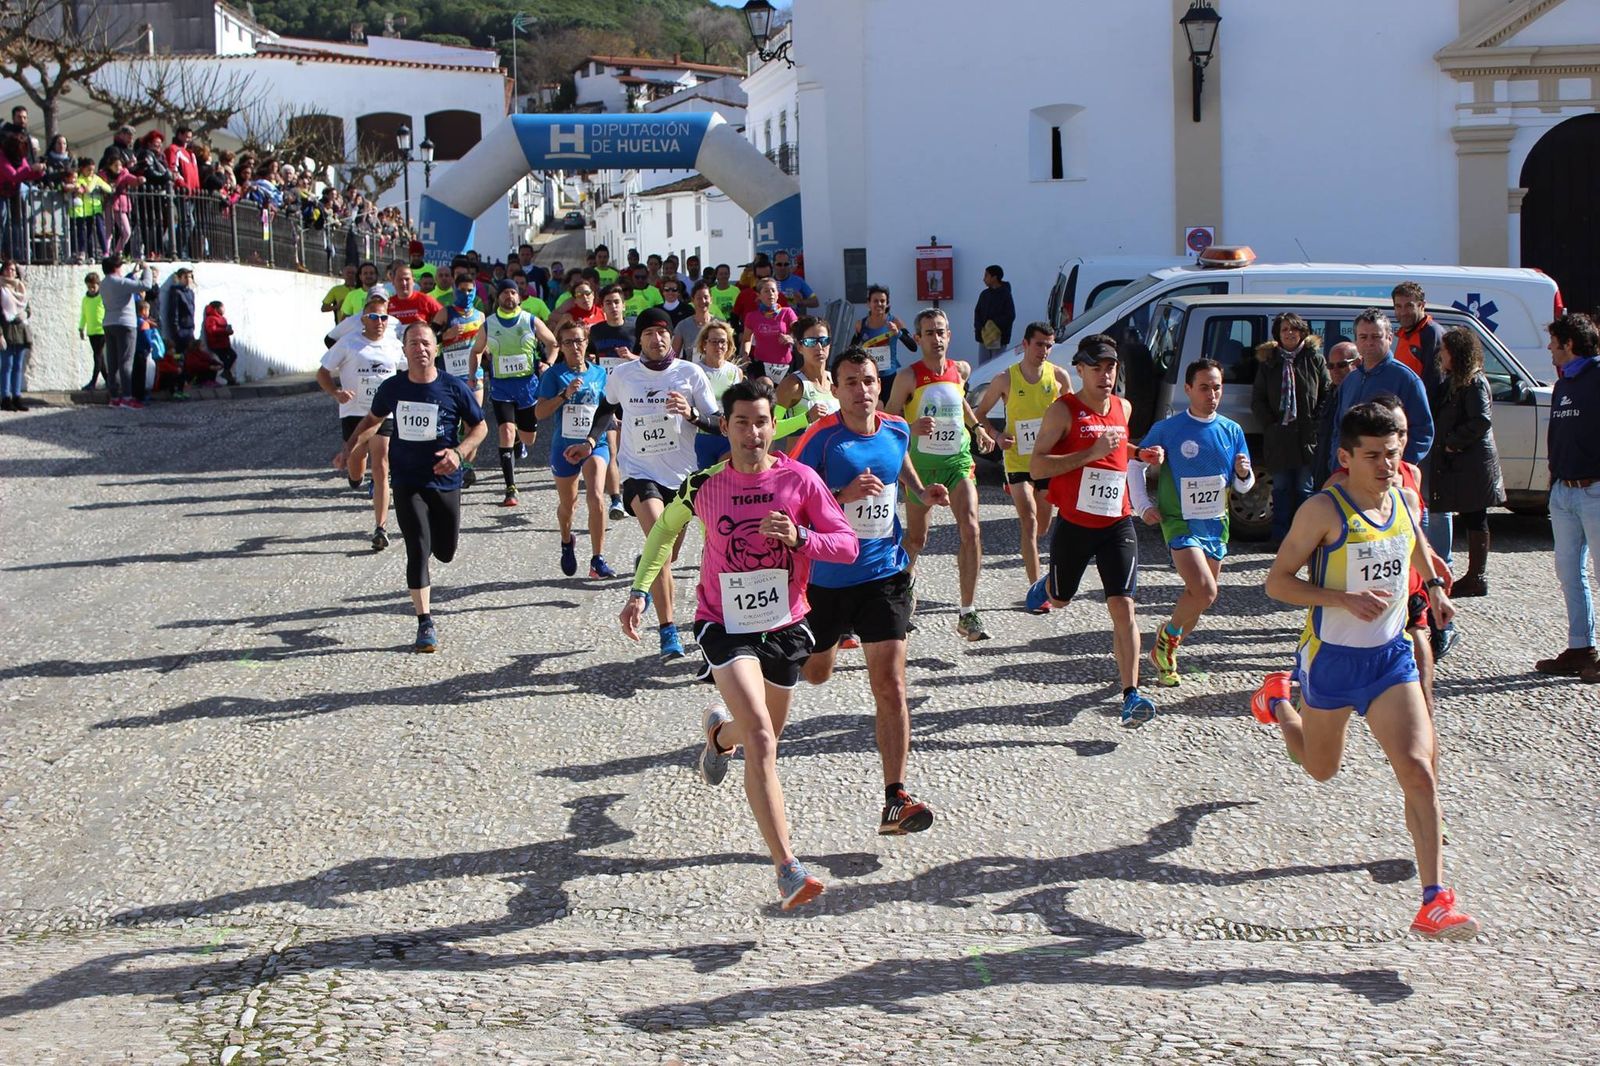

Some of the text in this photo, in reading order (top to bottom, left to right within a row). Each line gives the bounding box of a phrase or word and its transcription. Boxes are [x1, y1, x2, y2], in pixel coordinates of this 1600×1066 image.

[591, 121, 690, 137] DIPUTACIÓN
[591, 139, 680, 153] DE HUELVA
[504, 362, 524, 373] 1118
[366, 387, 378, 397] 63
[402, 415, 430, 428] 1109
[572, 416, 591, 428] 335
[643, 427, 666, 442] 642
[1024, 431, 1036, 442] 11
[1089, 484, 1119, 500] 1139
[1189, 490, 1220, 504] 1227
[731, 493, 775, 506] TIGRES
[855, 504, 889, 520] 1135
[1360, 558, 1402, 582] 1259
[734, 586, 779, 611] 1254
